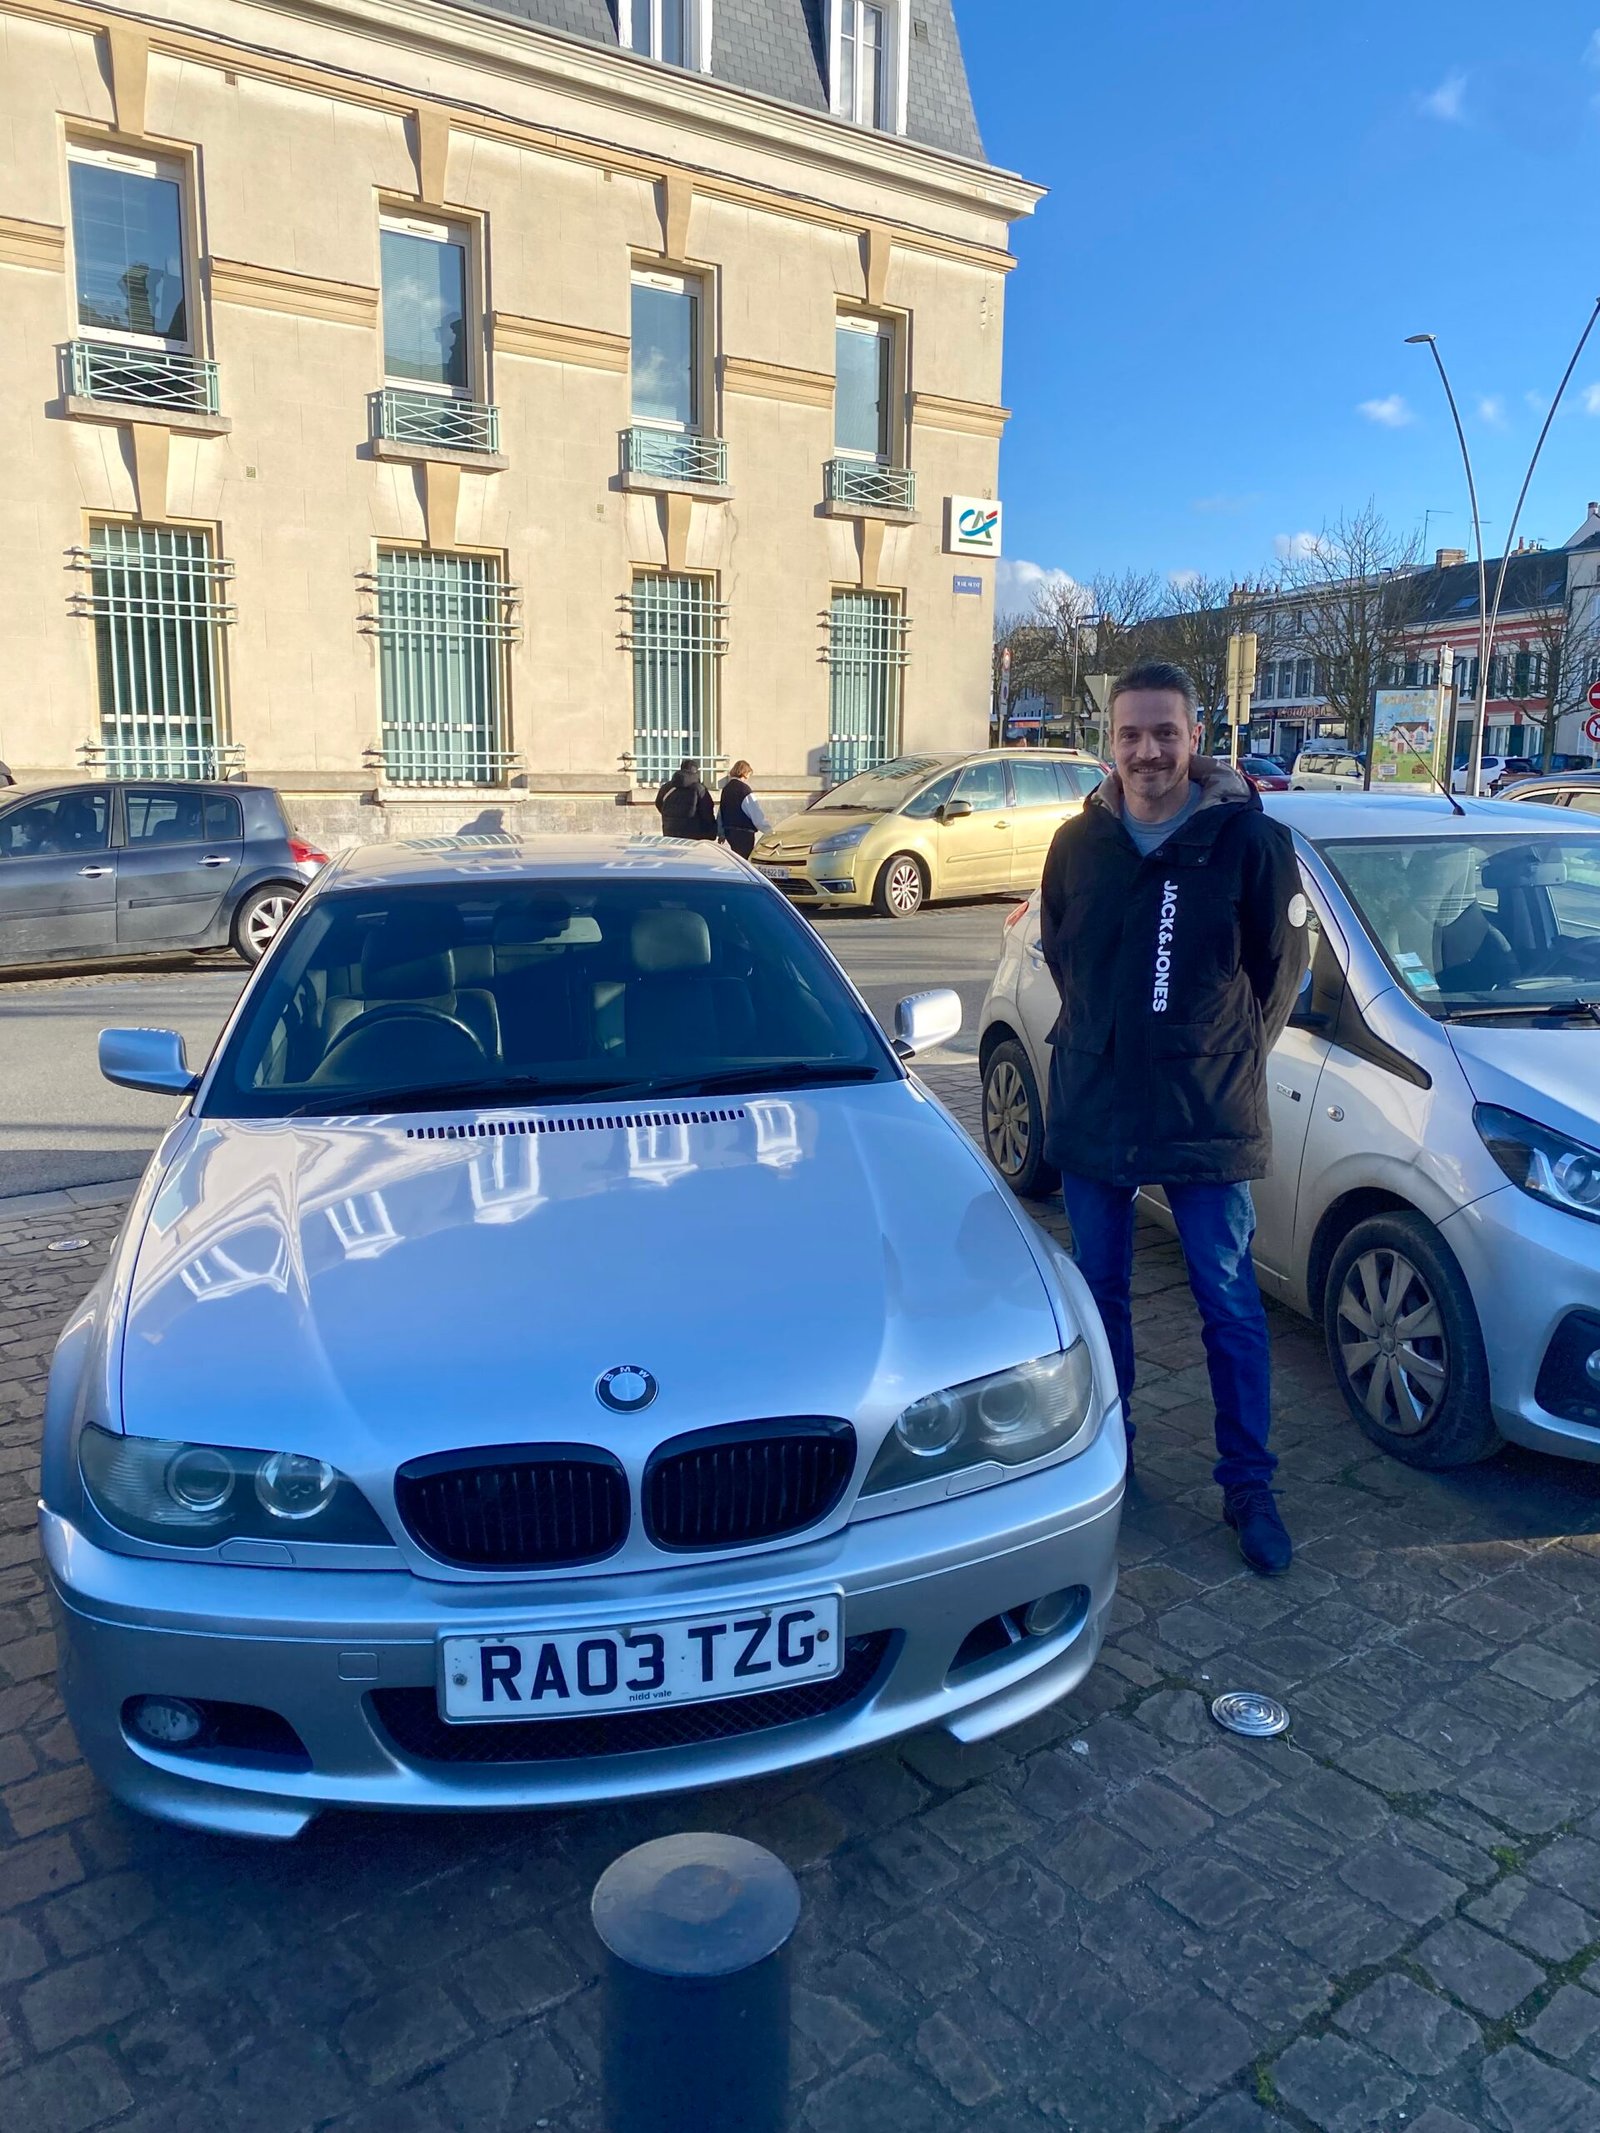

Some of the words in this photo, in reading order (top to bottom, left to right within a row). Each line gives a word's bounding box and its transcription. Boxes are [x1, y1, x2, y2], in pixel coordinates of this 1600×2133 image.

[603, 1367, 649, 1381] BMW
[481, 1634, 665, 1702] RA03
[688, 1609, 816, 1683] TZG
[653, 1690, 672, 1698] vale
